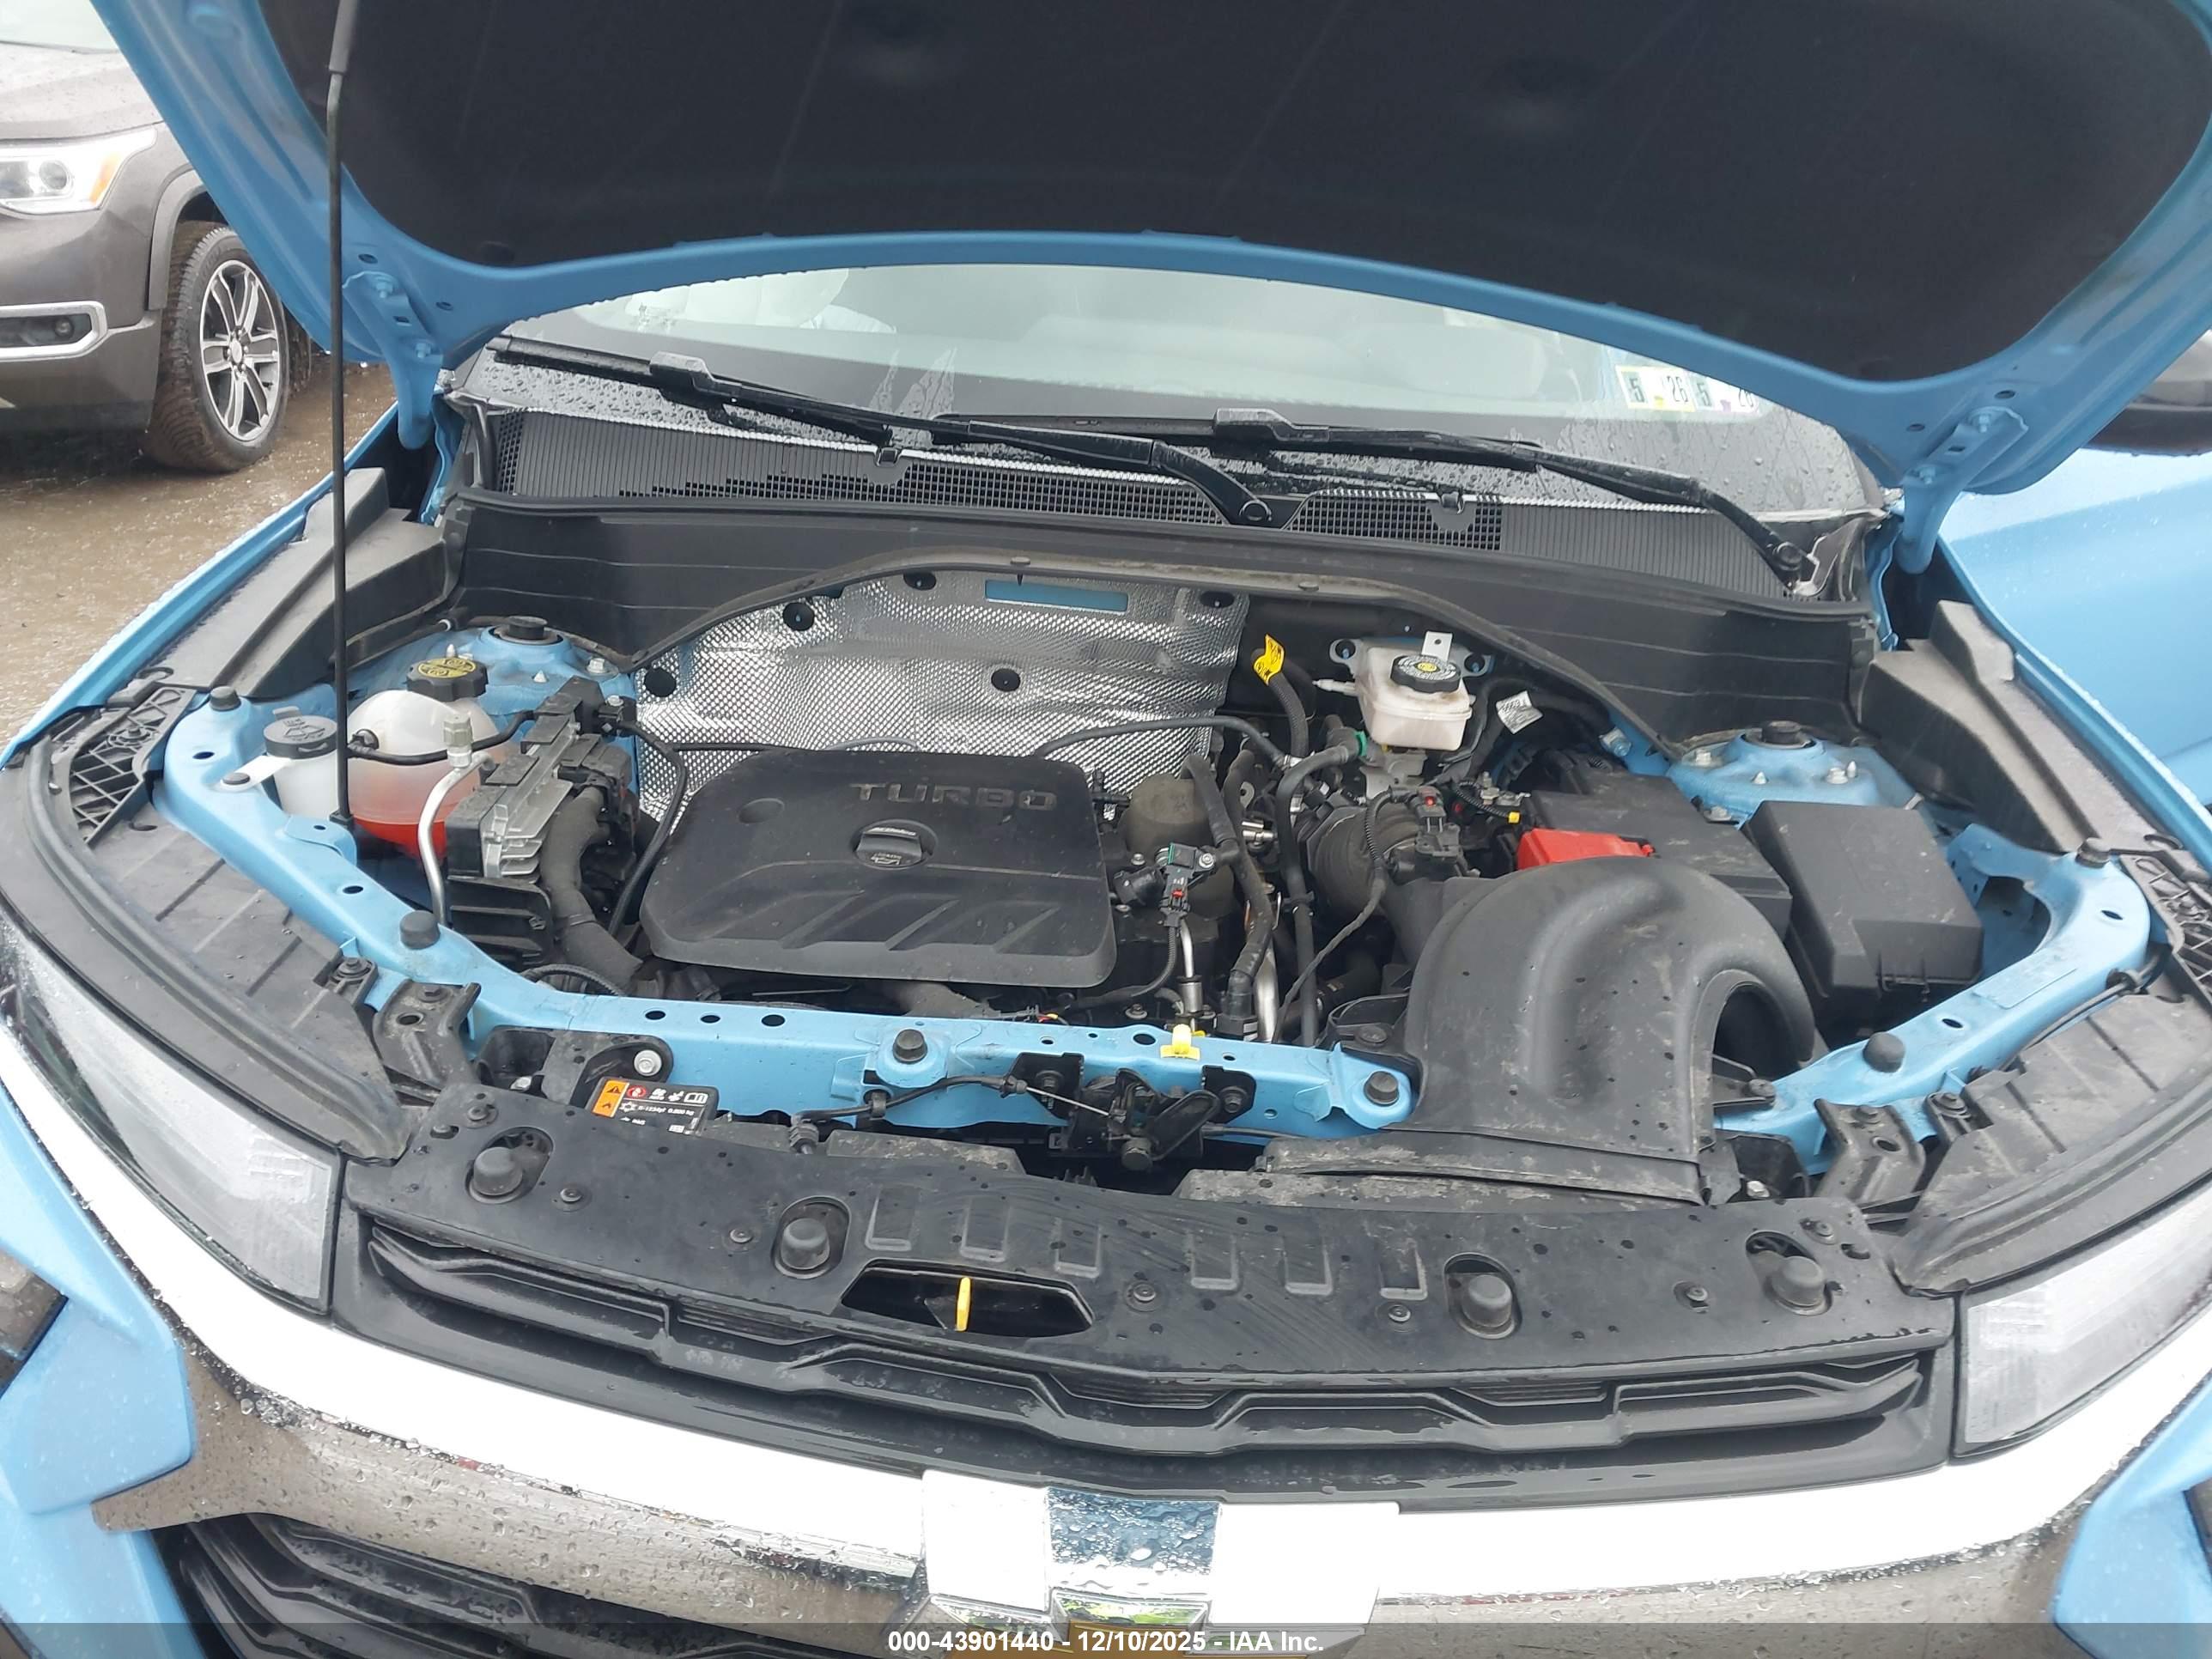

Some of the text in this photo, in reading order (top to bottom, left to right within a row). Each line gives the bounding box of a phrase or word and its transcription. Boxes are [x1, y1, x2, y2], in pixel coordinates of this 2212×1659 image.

[1629, 375, 1689, 404] 5 26
[1696, 381, 1712, 408] 5
[849, 783, 1057, 811] TURBO
